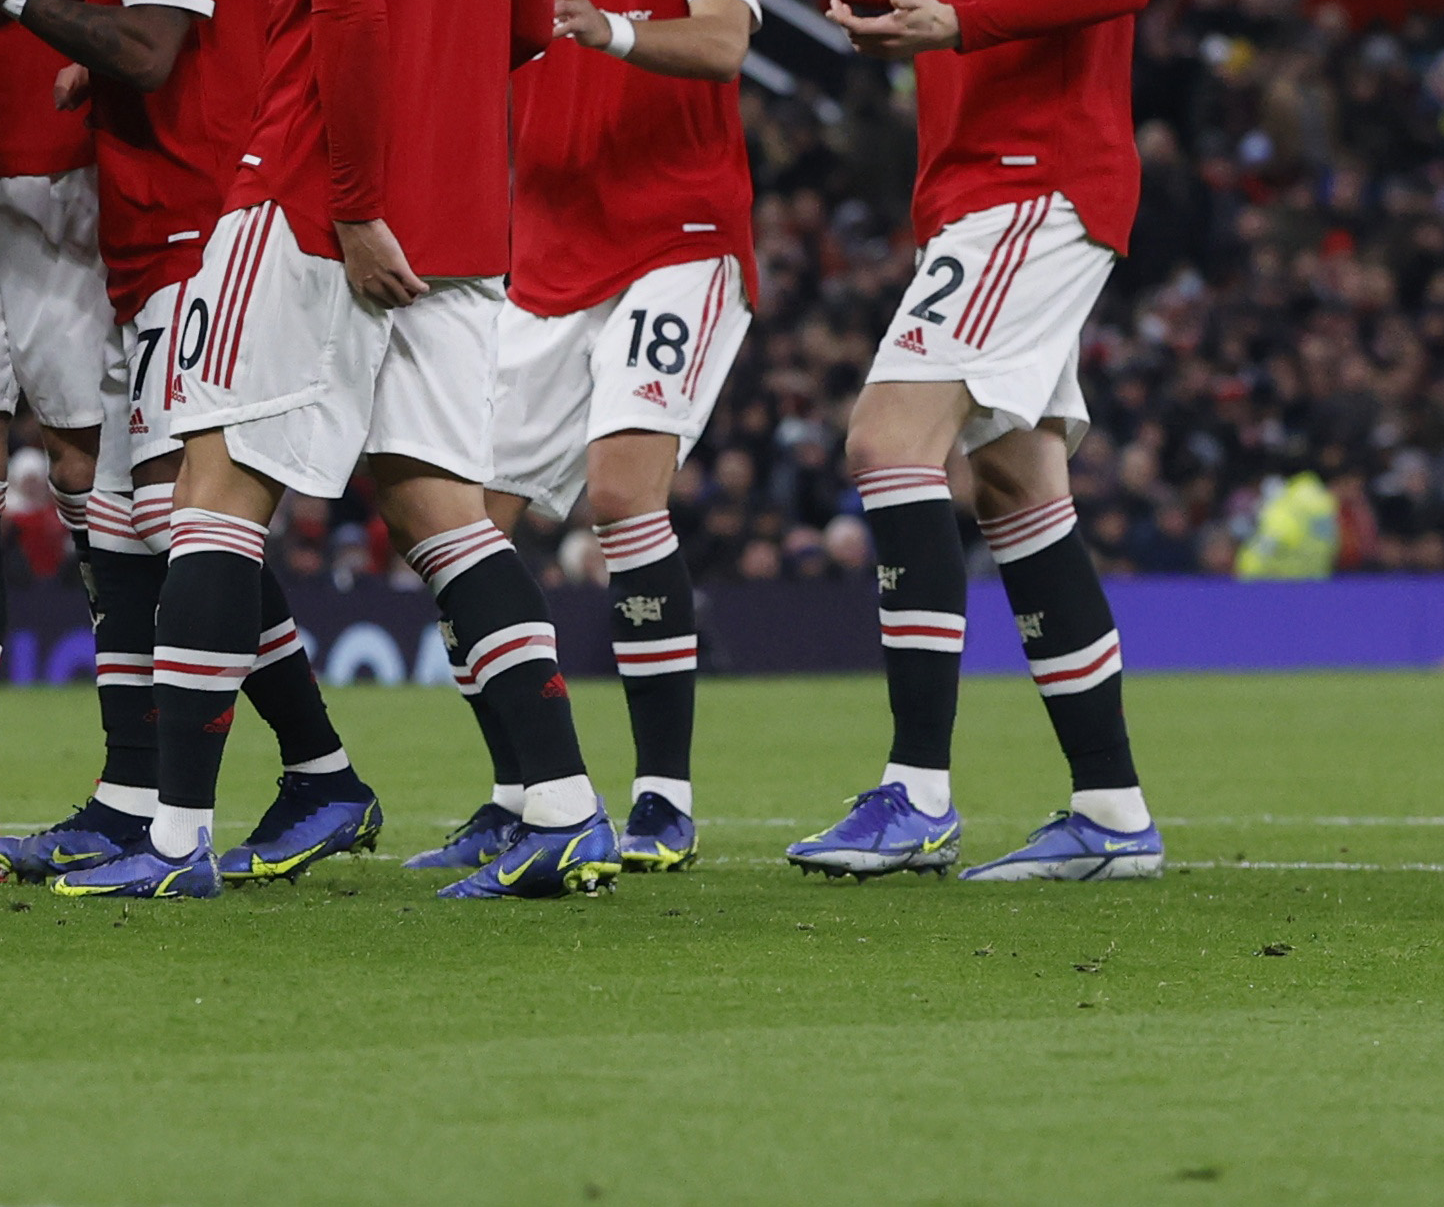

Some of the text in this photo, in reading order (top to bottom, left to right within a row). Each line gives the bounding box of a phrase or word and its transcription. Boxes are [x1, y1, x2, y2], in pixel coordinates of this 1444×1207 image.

[908, 256, 964, 326] 2
[131, 326, 166, 401] 7
[178, 297, 209, 370] 0
[626, 309, 690, 375] 18
